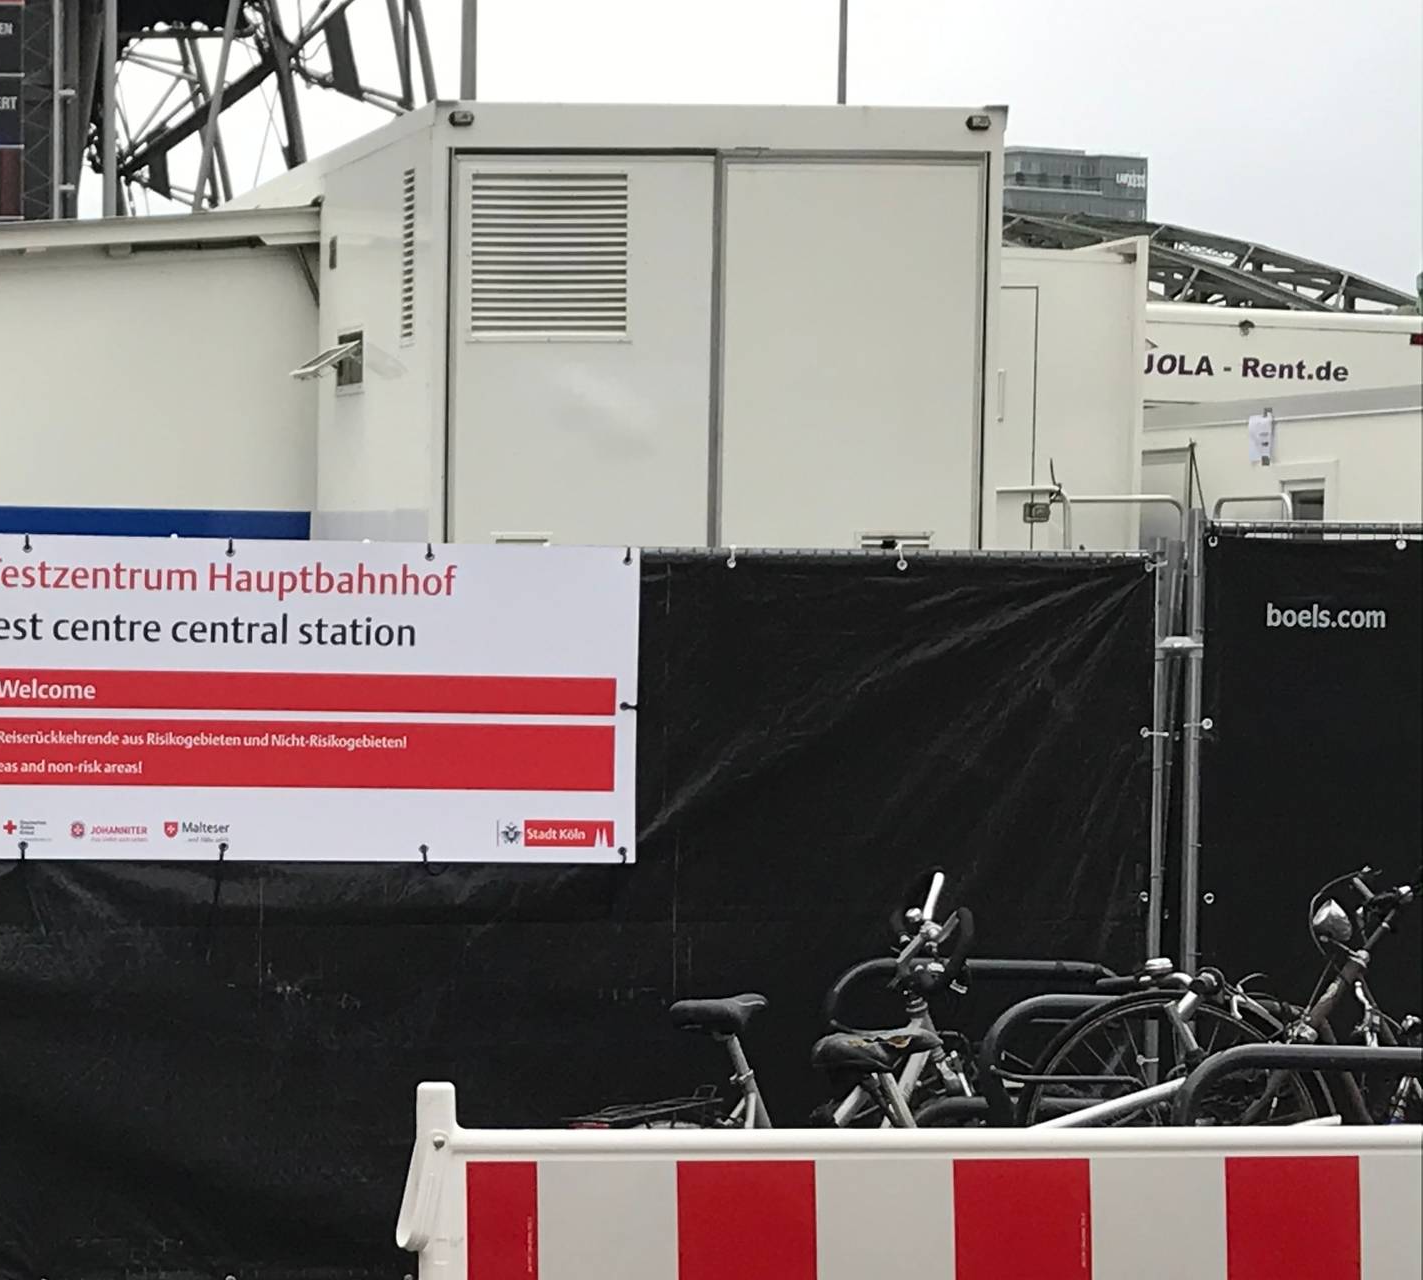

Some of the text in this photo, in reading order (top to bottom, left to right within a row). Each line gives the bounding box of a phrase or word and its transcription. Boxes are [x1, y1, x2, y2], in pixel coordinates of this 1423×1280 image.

[1144, 354, 1214, 376] JOLA
[1241, 357, 1349, 382] Rent.de
[208, 562, 458, 602] Hauptbahnhof
[1266, 602, 1387, 629] boels.com
[52, 613, 162, 643] centre
[171, 613, 289, 645] central
[298, 616, 417, 647] station
[122, 734, 144, 746] aus
[146, 732, 242, 749] Risikogebieten
[244, 733, 269, 747] und
[271, 733, 408, 752] Nicht-Risikogebieten!
[20, 759, 45, 773] and
[47, 759, 103, 773] non-risk
[104, 760, 143, 775] areas!
[90, 825, 148, 835] JOHANNITER
[182, 821, 230, 834] Malteser
[526, 828, 586, 840] Stadt Köln
